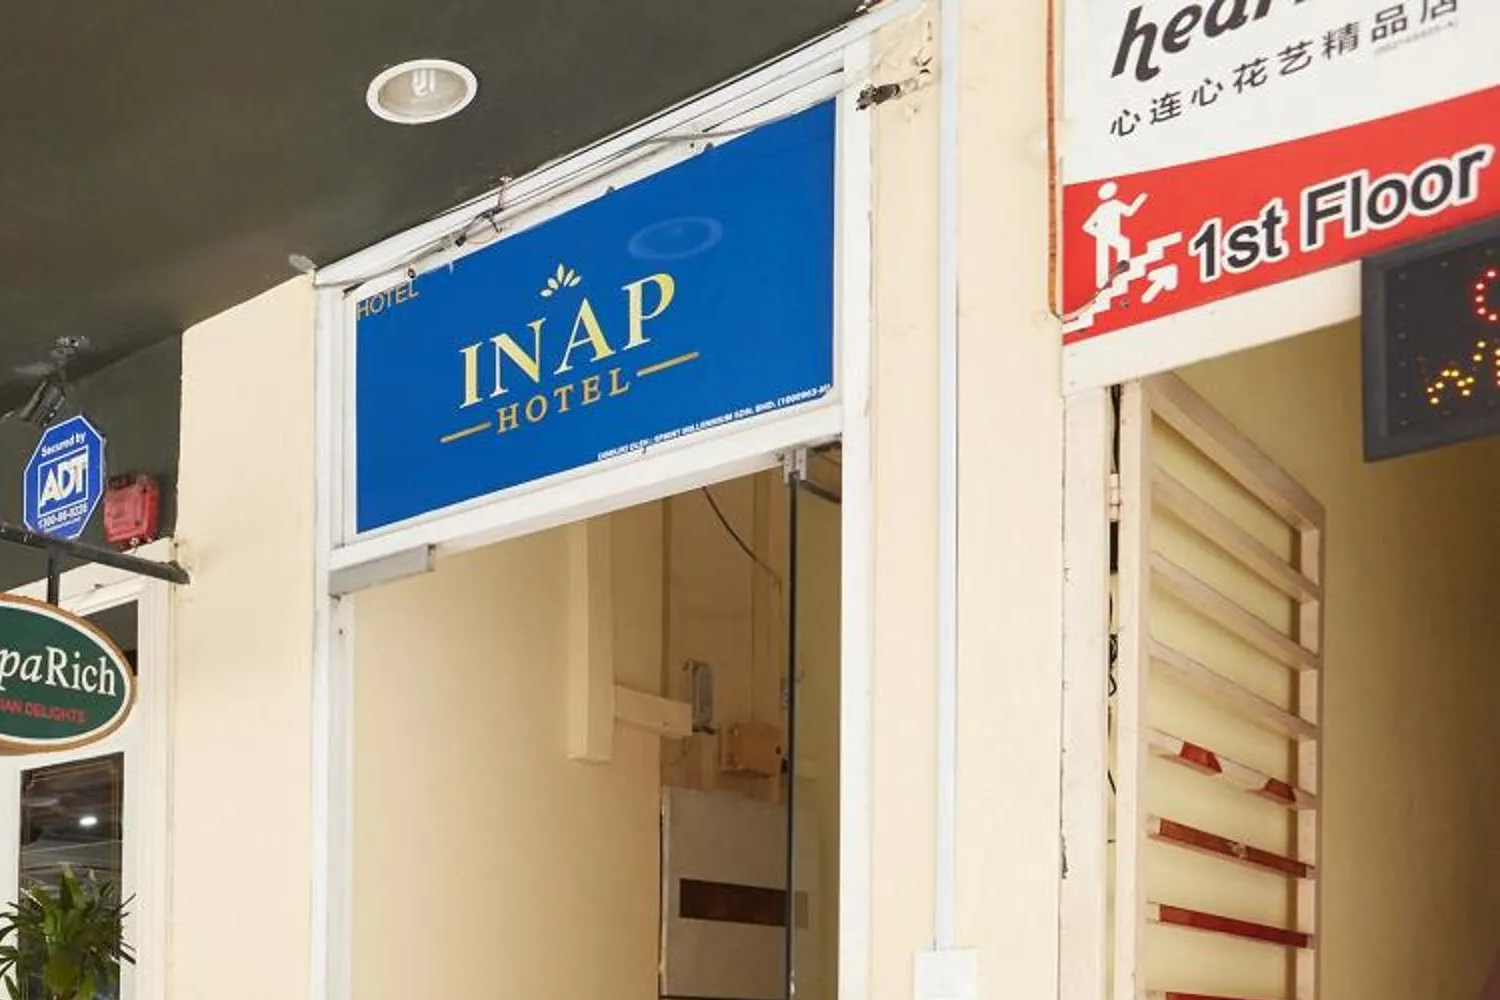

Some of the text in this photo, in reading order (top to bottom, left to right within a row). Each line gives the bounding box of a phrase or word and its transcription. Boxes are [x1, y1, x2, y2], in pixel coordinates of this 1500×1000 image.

[1109, 0, 1457, 137] 心连心花艺精品店
[1191, 147, 1490, 280] 1st Floor
[356, 281, 419, 320] HOTEL
[458, 272, 675, 408] INAP
[496, 366, 631, 433] HOTEL
[42, 431, 87, 457] Secured by
[40, 453, 88, 507] ADT
[25, 702, 87, 724] DELIGHTS
